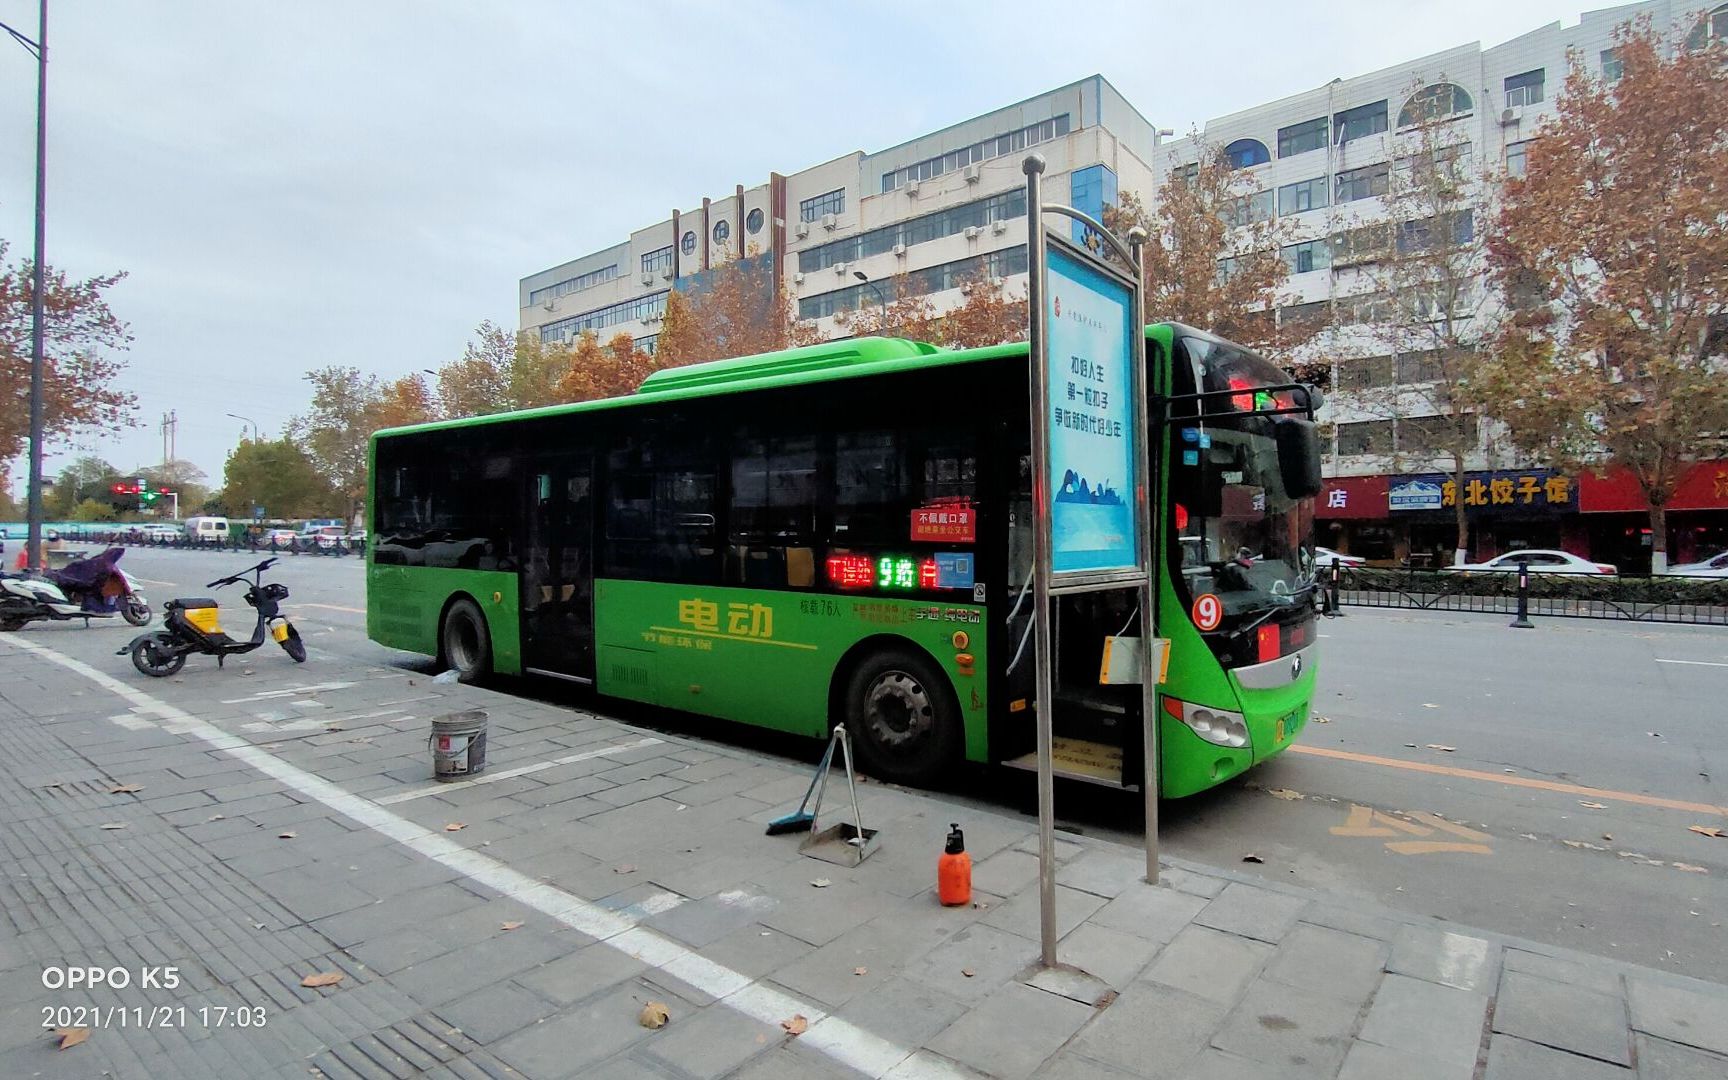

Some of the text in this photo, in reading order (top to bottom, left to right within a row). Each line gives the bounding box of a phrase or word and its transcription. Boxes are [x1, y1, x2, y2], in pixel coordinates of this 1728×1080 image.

[1071, 356, 1104, 383] 扣好人生
[1067, 381, 1109, 409] 第一粒扣子
[1055, 407, 1122, 438] 争做新时代好少年
[1328, 488, 1347, 509] 店
[1441, 475, 1570, 507] 东北饺子馆
[919, 512, 968, 524] 不佩戴口罩
[678, 598, 774, 638] 电动
[1199, 598, 1217, 628] 9
